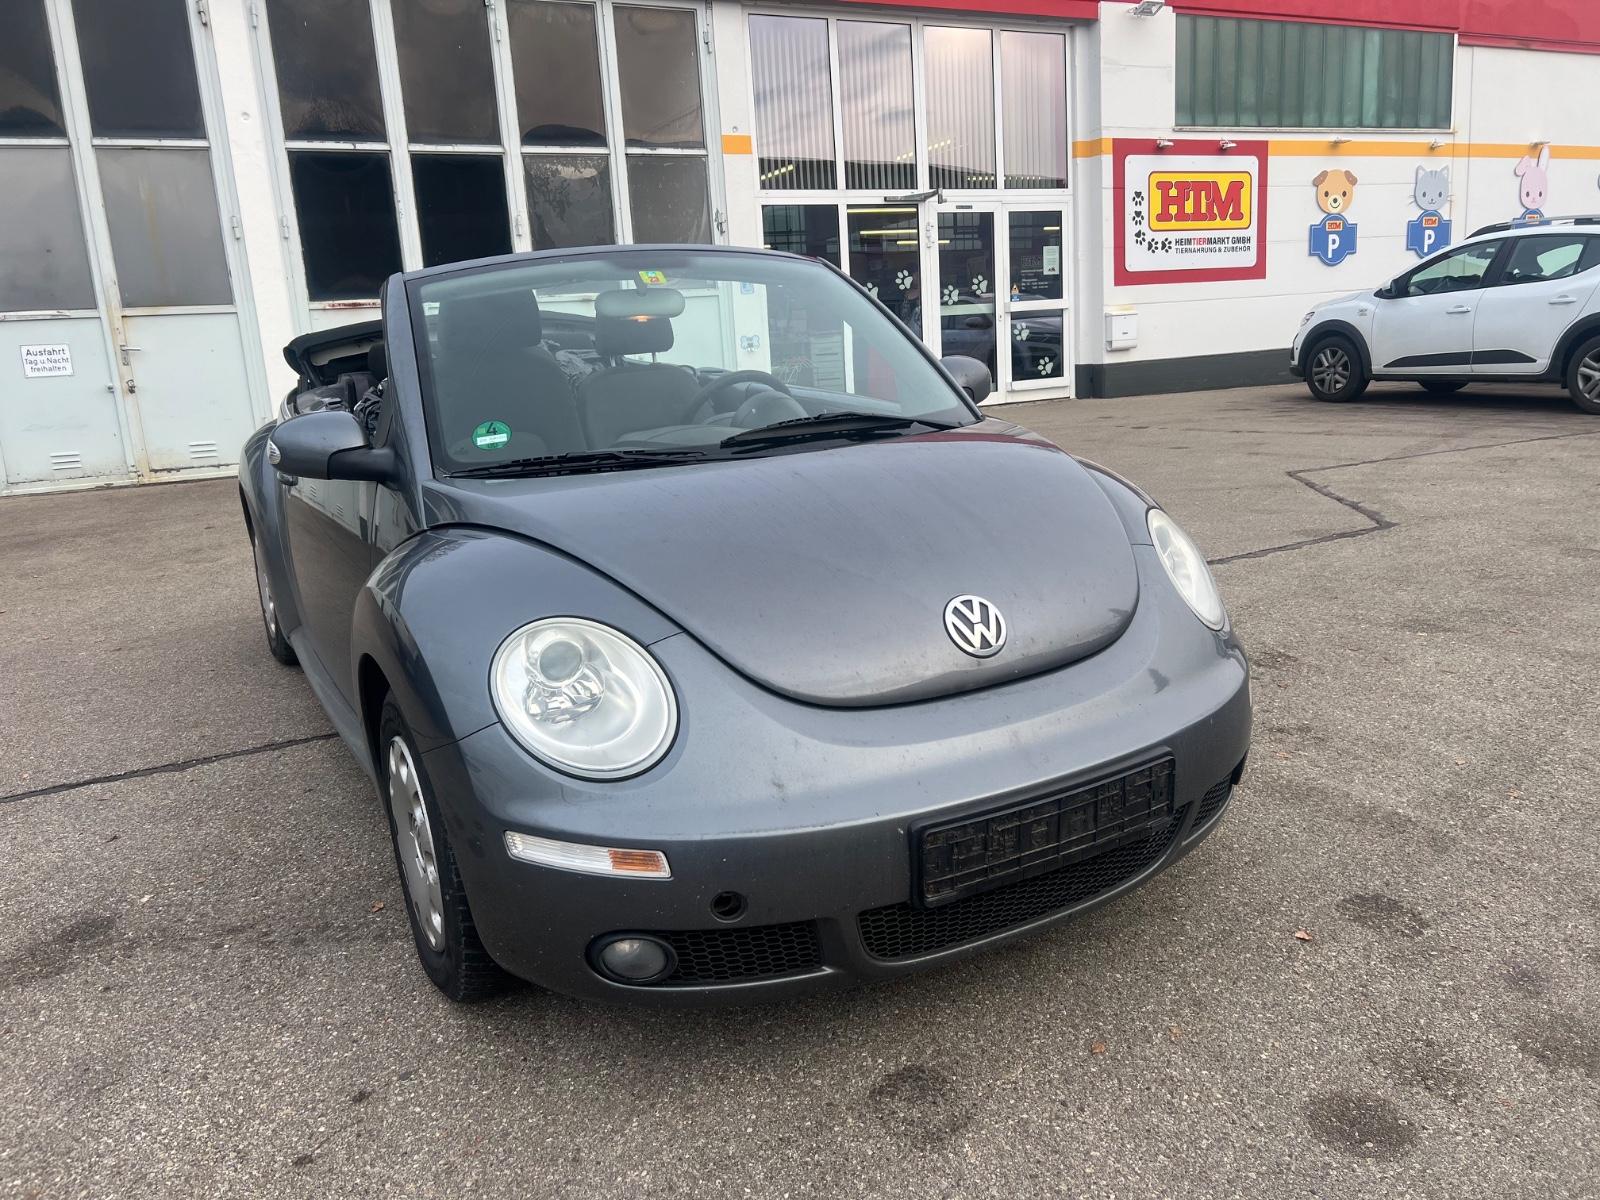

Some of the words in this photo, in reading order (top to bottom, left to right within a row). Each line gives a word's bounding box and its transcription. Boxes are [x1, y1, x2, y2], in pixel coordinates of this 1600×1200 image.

[1155, 180, 1245, 222] HTM
[1174, 237, 1230, 246] HEIMTIERMARKT
[1231, 236, 1251, 244] GMBH
[1328, 234, 1339, 258] P
[1424, 230, 1435, 252] P
[26, 348, 66, 357] Ausfahrt
[24, 358, 38, 366] Tag
[486, 422, 498, 435] 4
[945, 595, 1006, 656] VW
